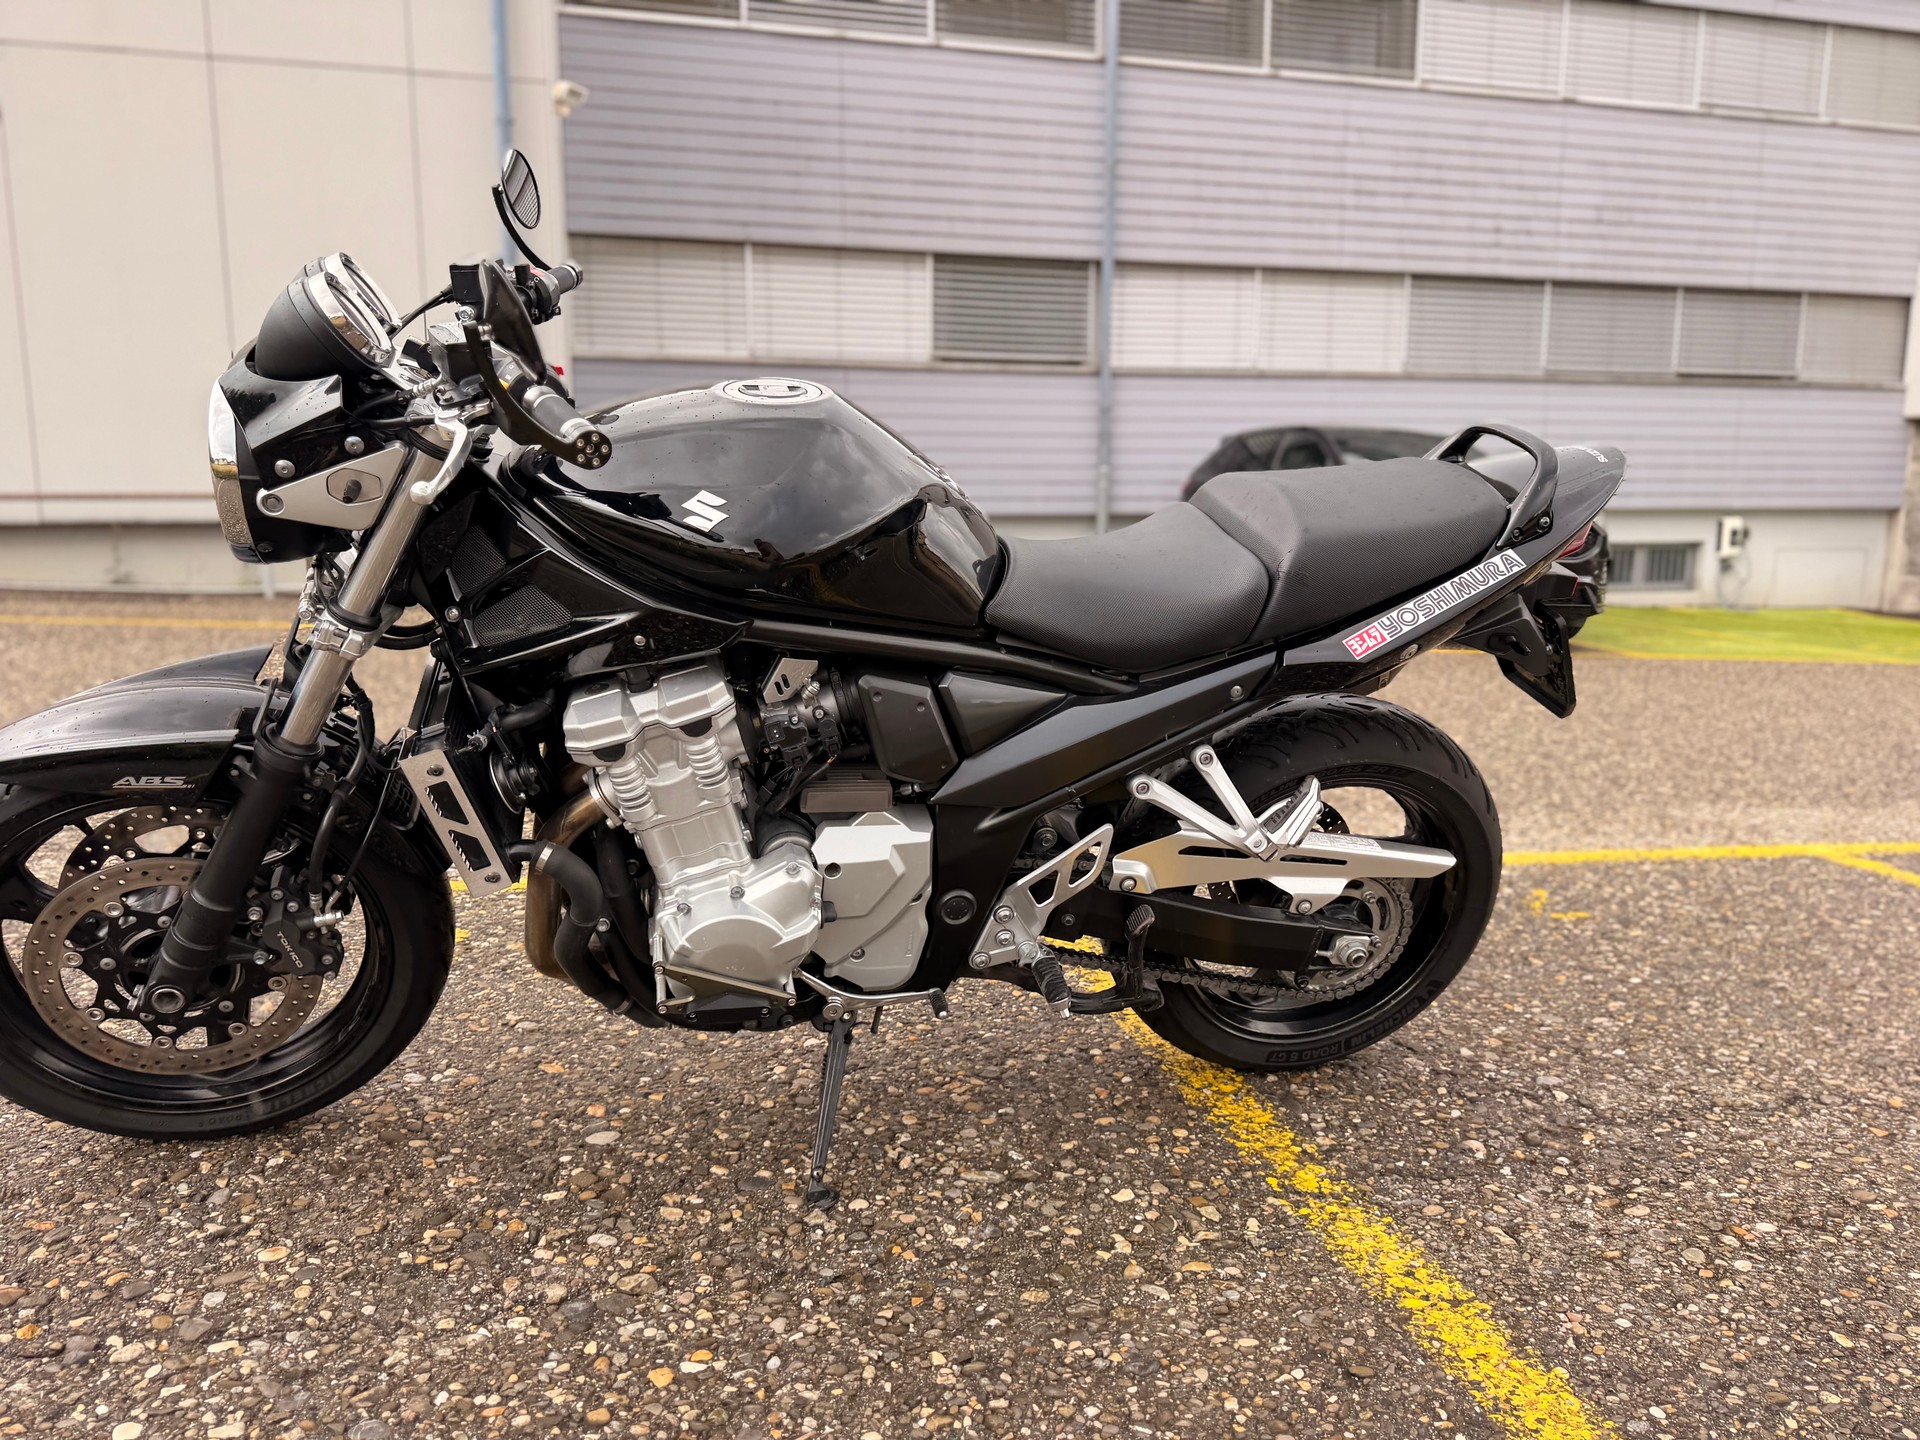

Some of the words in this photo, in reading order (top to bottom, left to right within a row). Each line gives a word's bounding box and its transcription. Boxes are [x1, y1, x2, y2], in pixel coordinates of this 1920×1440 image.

[1377, 553, 1524, 639] YOSHIMURA
[1346, 627, 1383, 656] ヨシムラ
[111, 776, 188, 787] ABS
[277, 931, 304, 968] TOKICO
[1350, 997, 1420, 1049] MICHELIN
[1303, 1043, 1339, 1060] ROAD
